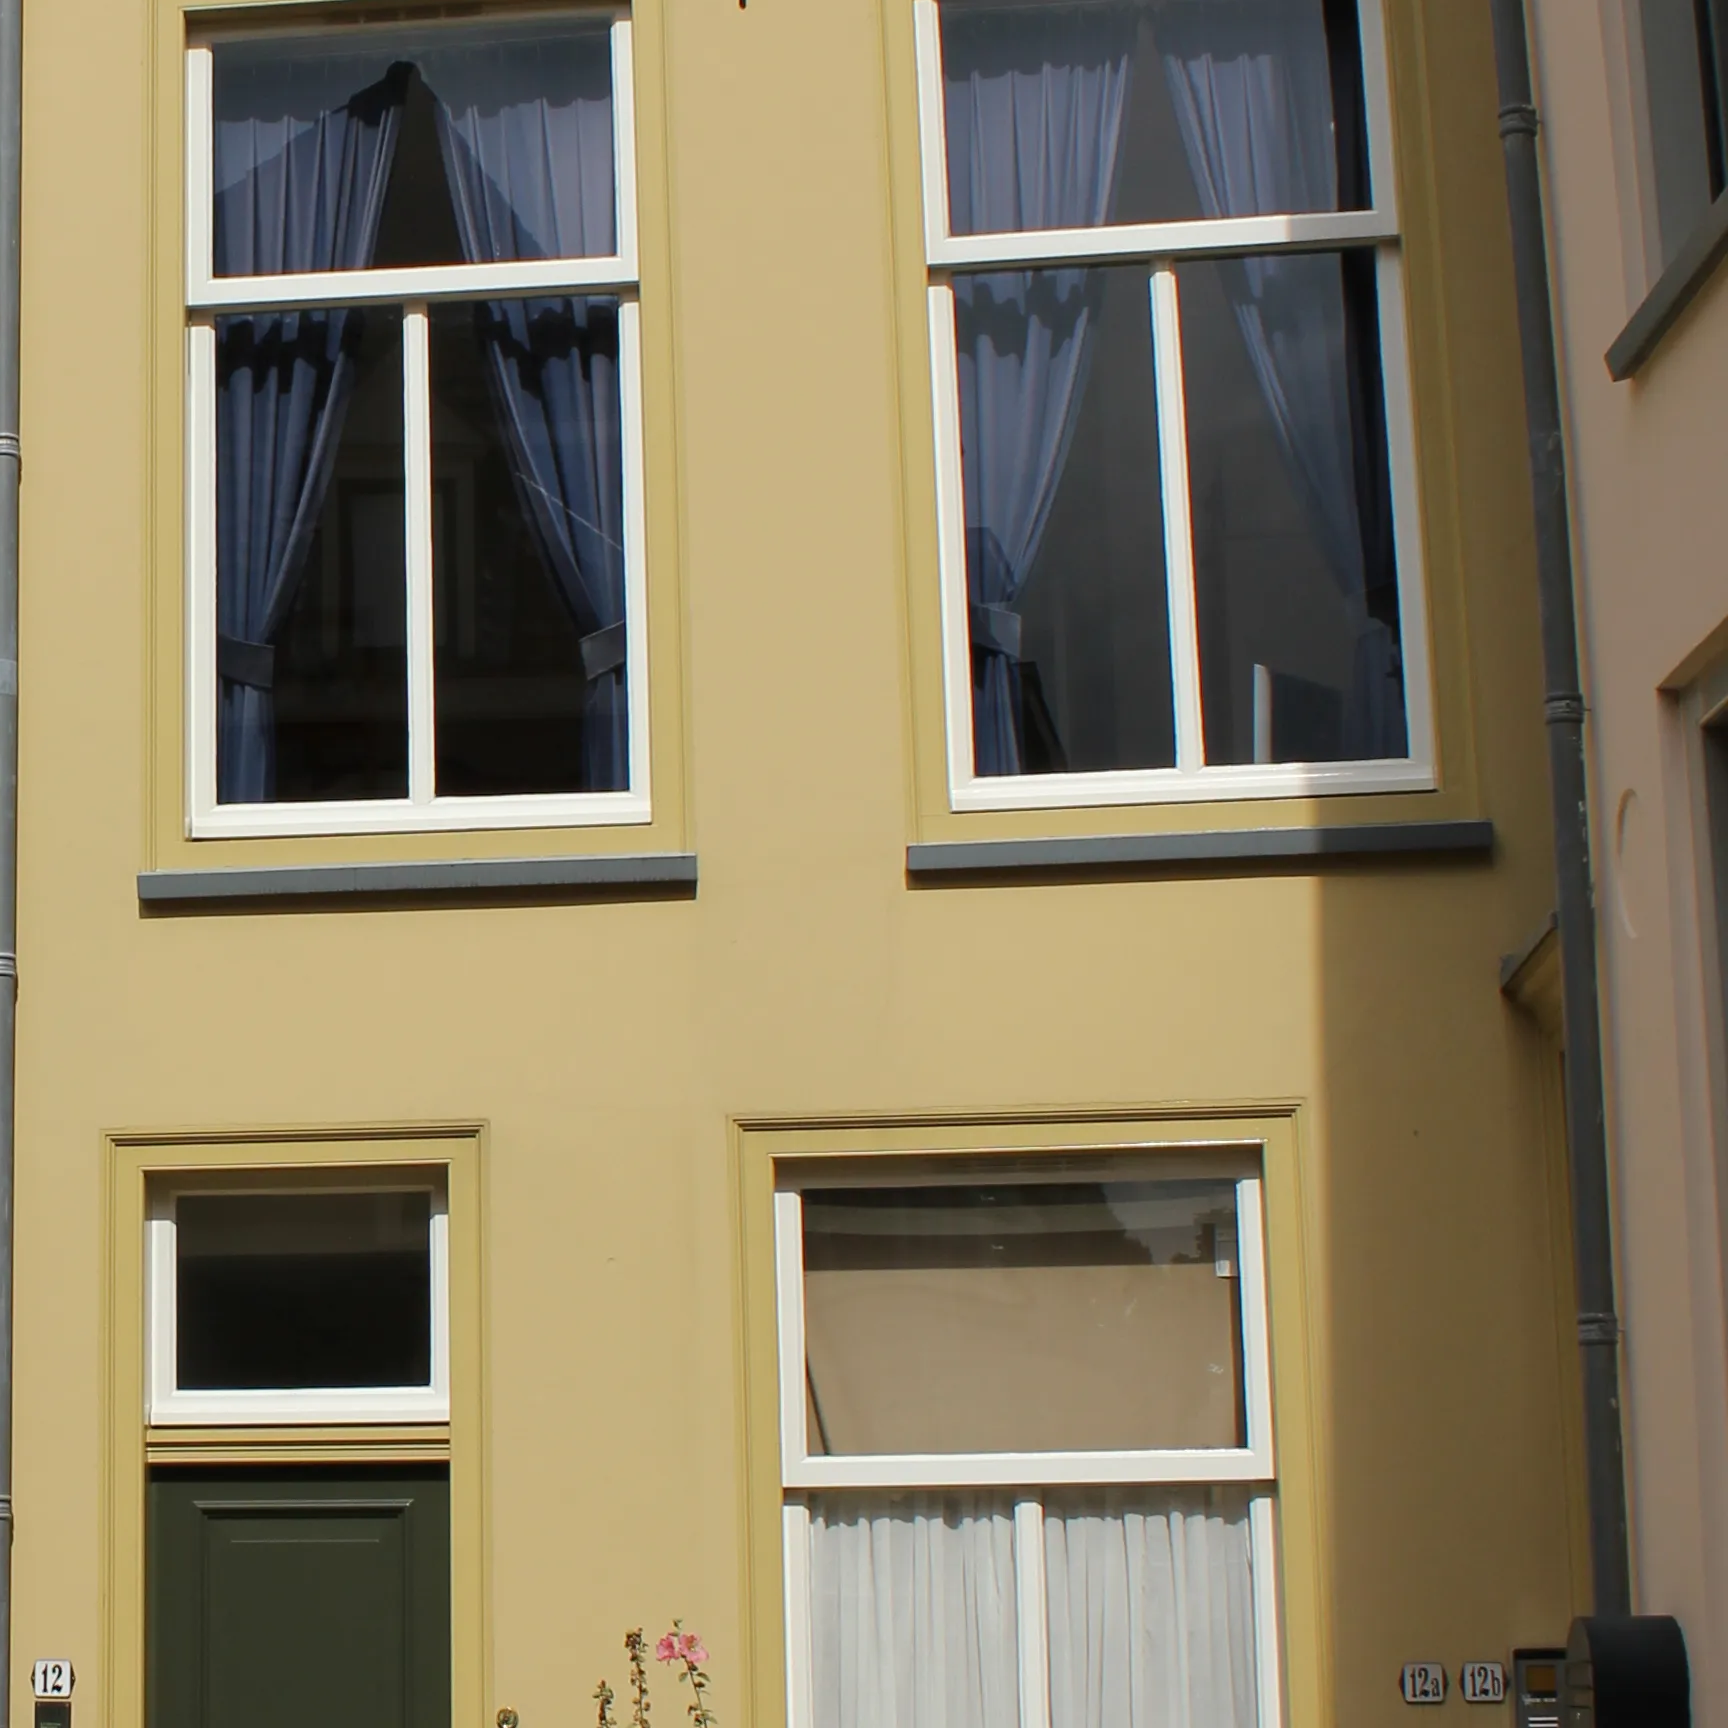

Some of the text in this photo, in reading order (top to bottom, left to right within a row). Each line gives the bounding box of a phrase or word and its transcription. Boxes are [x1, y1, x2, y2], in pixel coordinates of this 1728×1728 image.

[41, 1663, 63, 1693] 12
[1409, 1666, 1440, 1698] 12a
[1469, 1665, 1501, 1697] 12b
